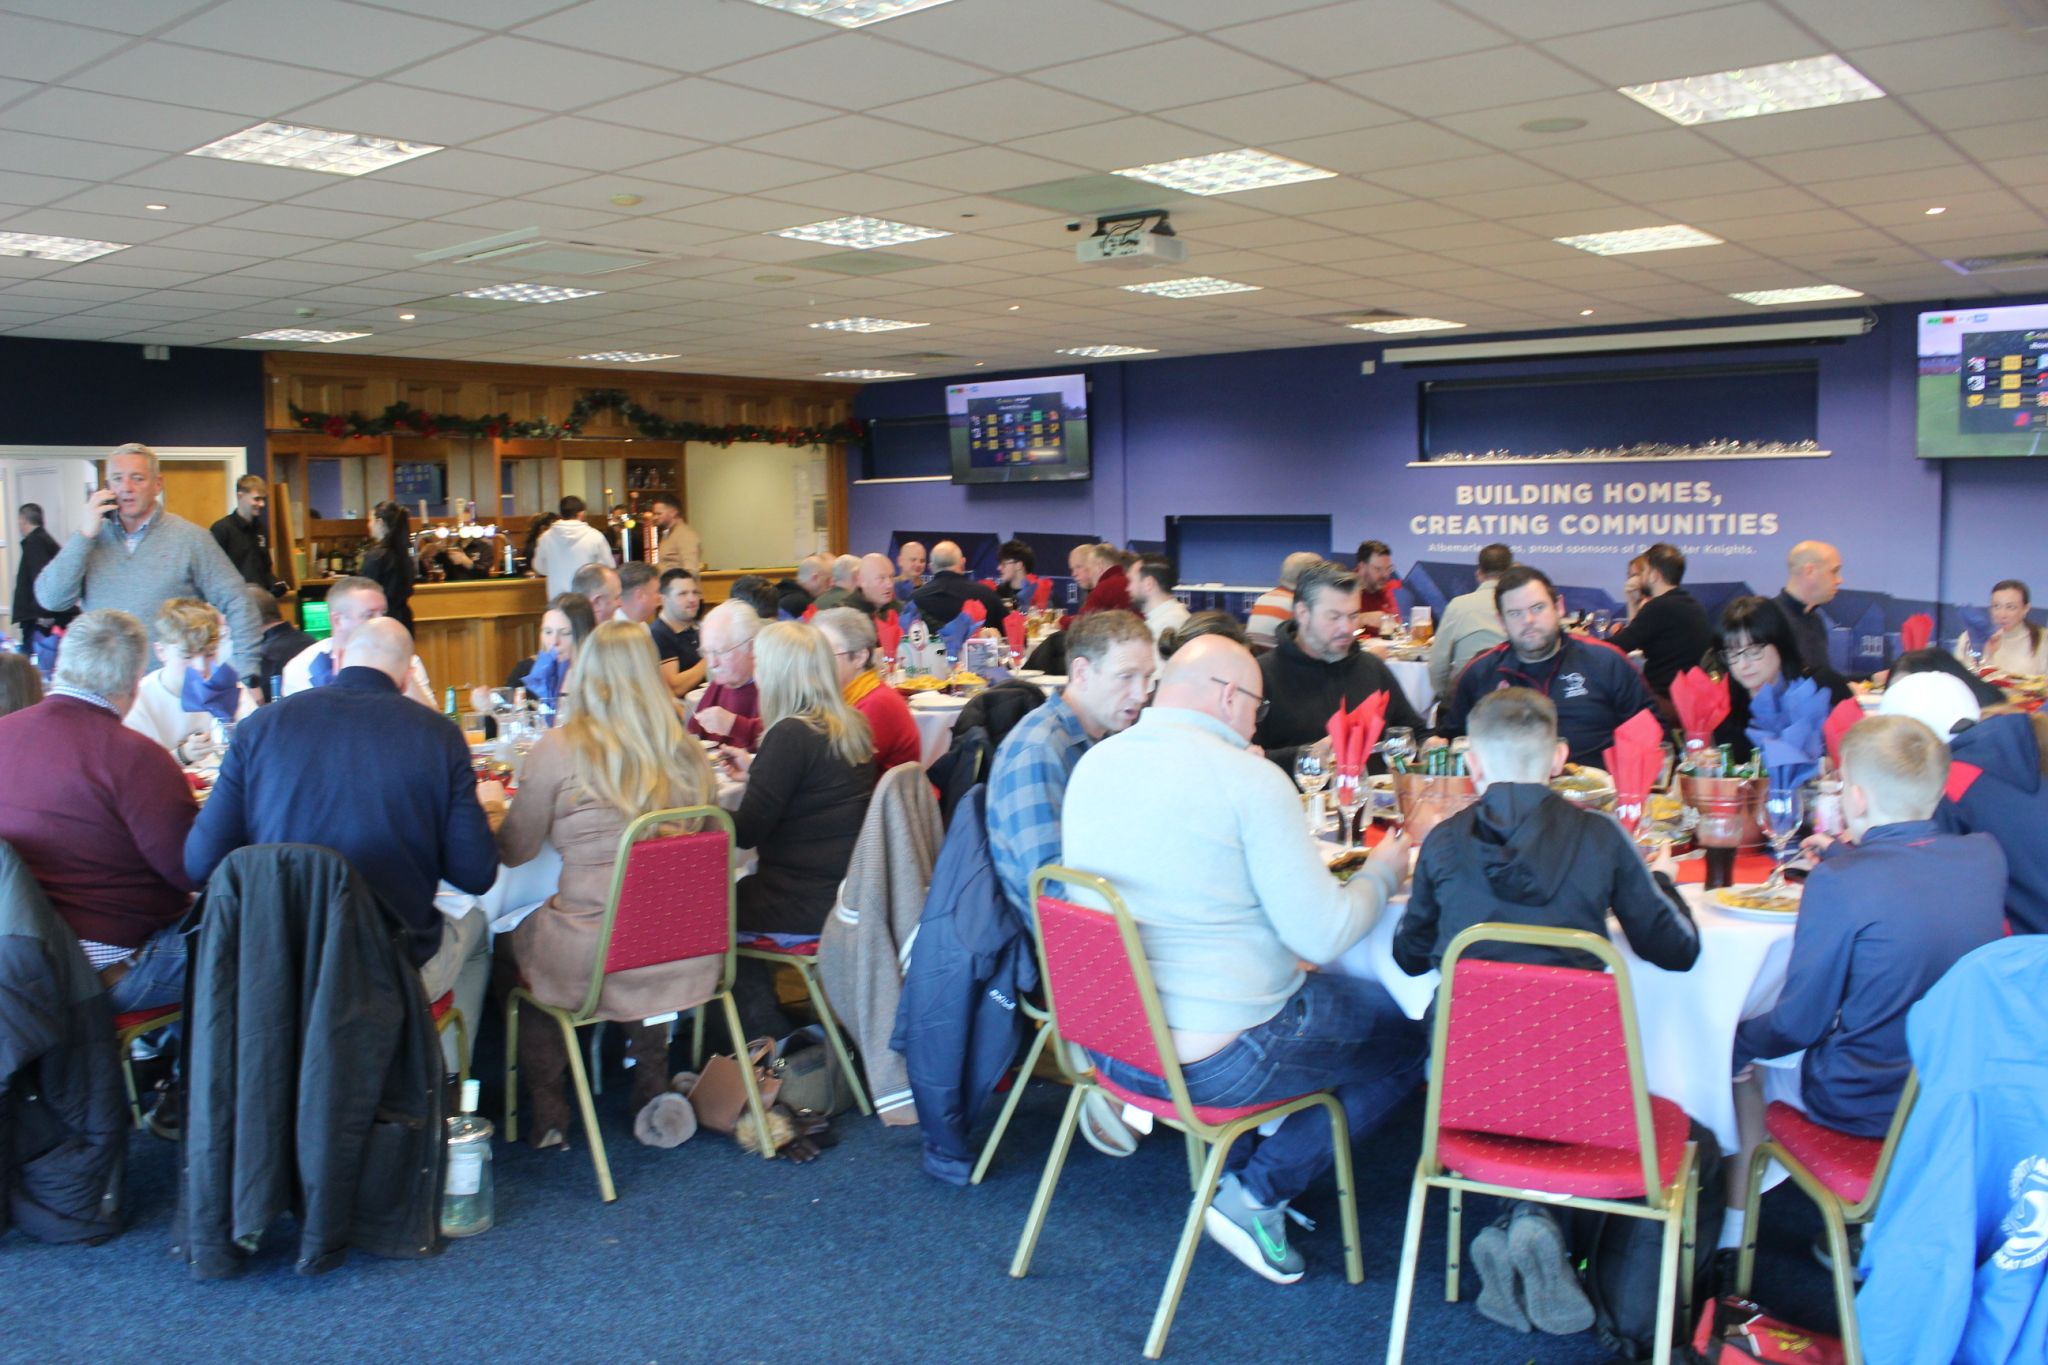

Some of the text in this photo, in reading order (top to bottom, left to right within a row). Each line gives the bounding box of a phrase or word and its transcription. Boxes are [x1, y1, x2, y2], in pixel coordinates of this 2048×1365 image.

[1456, 481, 1723, 507] BUILDING HOMES,
[1410, 513, 1779, 536] CREATING COMMUNITIES
[1567, 544, 1619, 555] sponsors
[1622, 543, 1636, 554] of
